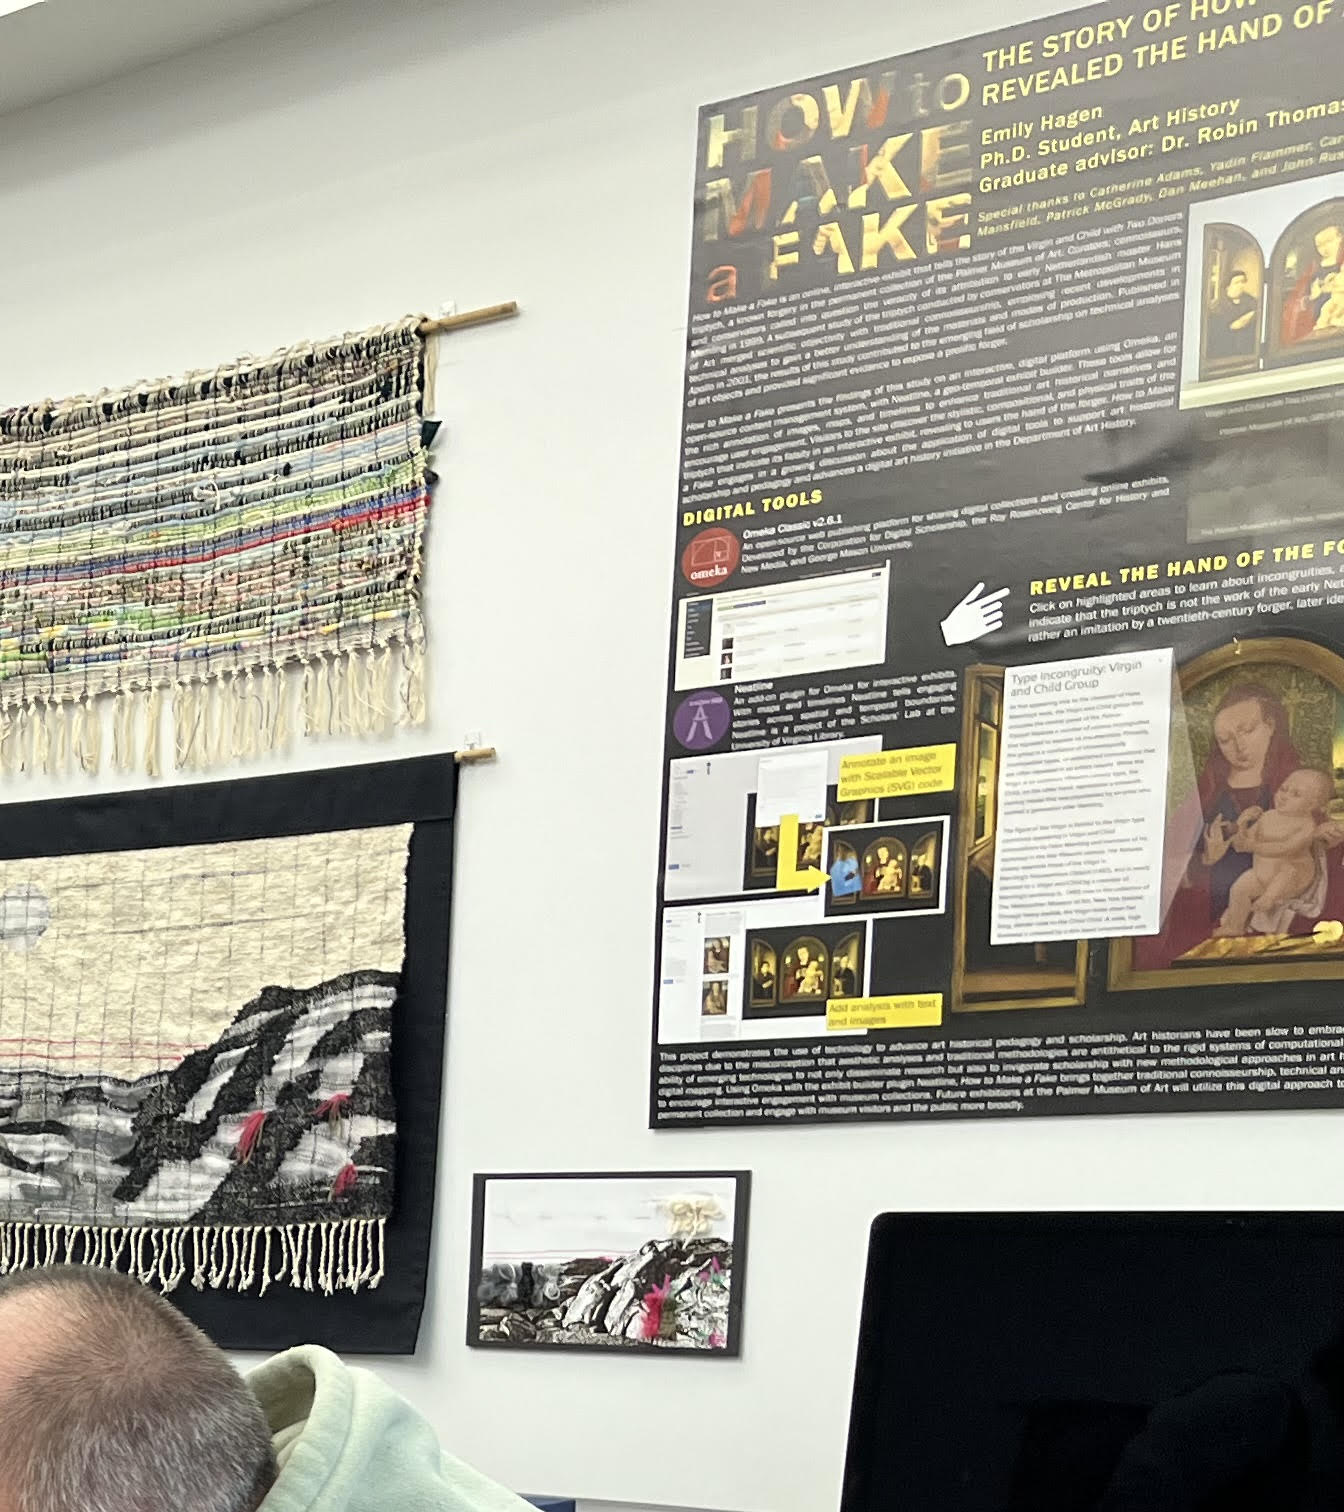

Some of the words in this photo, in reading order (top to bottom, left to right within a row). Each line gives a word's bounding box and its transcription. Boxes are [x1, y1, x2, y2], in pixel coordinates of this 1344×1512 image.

[982, 40, 1033, 72] THE
[1042, 15, 1133, 58] STORY
[1142, 3, 1181, 32] OF
[982, 53, 1123, 105] REVEALED
[1132, 35, 1188, 68] THE
[1197, 13, 1283, 53] HAND
[1292, 0, 1333, 29] OF
[706, 70, 896, 169] HOW
[908, 72, 972, 118] to
[979, 145, 1031, 169] Ph.D.
[1037, 125, 1121, 156] Student,
[1127, 114, 1160, 136] Art
[1166, 98, 1240, 126] History
[980, 121, 1034, 145] Emily
[1040, 106, 1103, 131] Hagen
[978, 162, 1069, 193] Graduate
[1074, 143, 1154, 172] advisor:
[1160, 134, 1189, 153] Dr.
[1197, 119, 1258, 144] Robin
[703, 120, 974, 241] MAKE
[706, 264, 738, 304] a
[764, 192, 973, 288] FAKE
[682, 501, 755, 526] DIGITAL
[761, 489, 823, 512] TOOLS
[689, 563, 729, 581] omeka
[1028, 600, 1056, 614] Click
[1057, 599, 1074, 610] on
[1075, 589, 1137, 608] highlighted
[1138, 586, 1172, 599] areas
[1173, 583, 1187, 595] to
[1188, 580, 1219, 593] learn
[1220, 574, 1254, 589] about
[1256, 566, 1335, 583] incongruities,
[1029, 571, 1112, 595] REVEAL
[1118, 563, 1159, 583] THE
[1166, 555, 1228, 577] HAND
[1235, 549, 1265, 568] OF
[1272, 543, 1314, 562] THE
[1027, 628, 1062, 643] rather
[1062, 627, 1079, 639] an
[1079, 621, 1130, 636] imitation
[1130, 618, 1146, 631] by
[1145, 617, 1155, 628] a
[1156, 605, 1255, 626] twentieth-century
[1255, 600, 1294, 614] forger,
[1295, 596, 1325, 609] later
[1028, 613, 1073, 628] indicate
[1074, 609, 1098, 623] that
[1099, 607, 1120, 619] the
[1121, 600, 1164, 617] triptych
[1165, 599, 1177, 611] is
[1178, 596, 1199, 609] not
[1200, 594, 1221, 606] the
[1222, 589, 1251, 603] work
[1252, 586, 1267, 599] of
[1267, 585, 1289, 597] the
[1290, 581, 1321, 594] early
[1009, 684, 1032, 698] and
[1032, 680, 1063, 695] Child
[1063, 678, 1100, 691] Group
[1011, 673, 1039, 687] Type
[1039, 664, 1107, 682] Incongruity:
[1107, 660, 1143, 674] Virgin
[1130, 1030, 1148, 1042] Art
[1150, 1030, 1202, 1041] historians
[1204, 1028, 1231, 1039] have
[1233, 1027, 1262, 1038] been
[1264, 1026, 1290, 1037] slow
[1292, 1025, 1305, 1036] to
